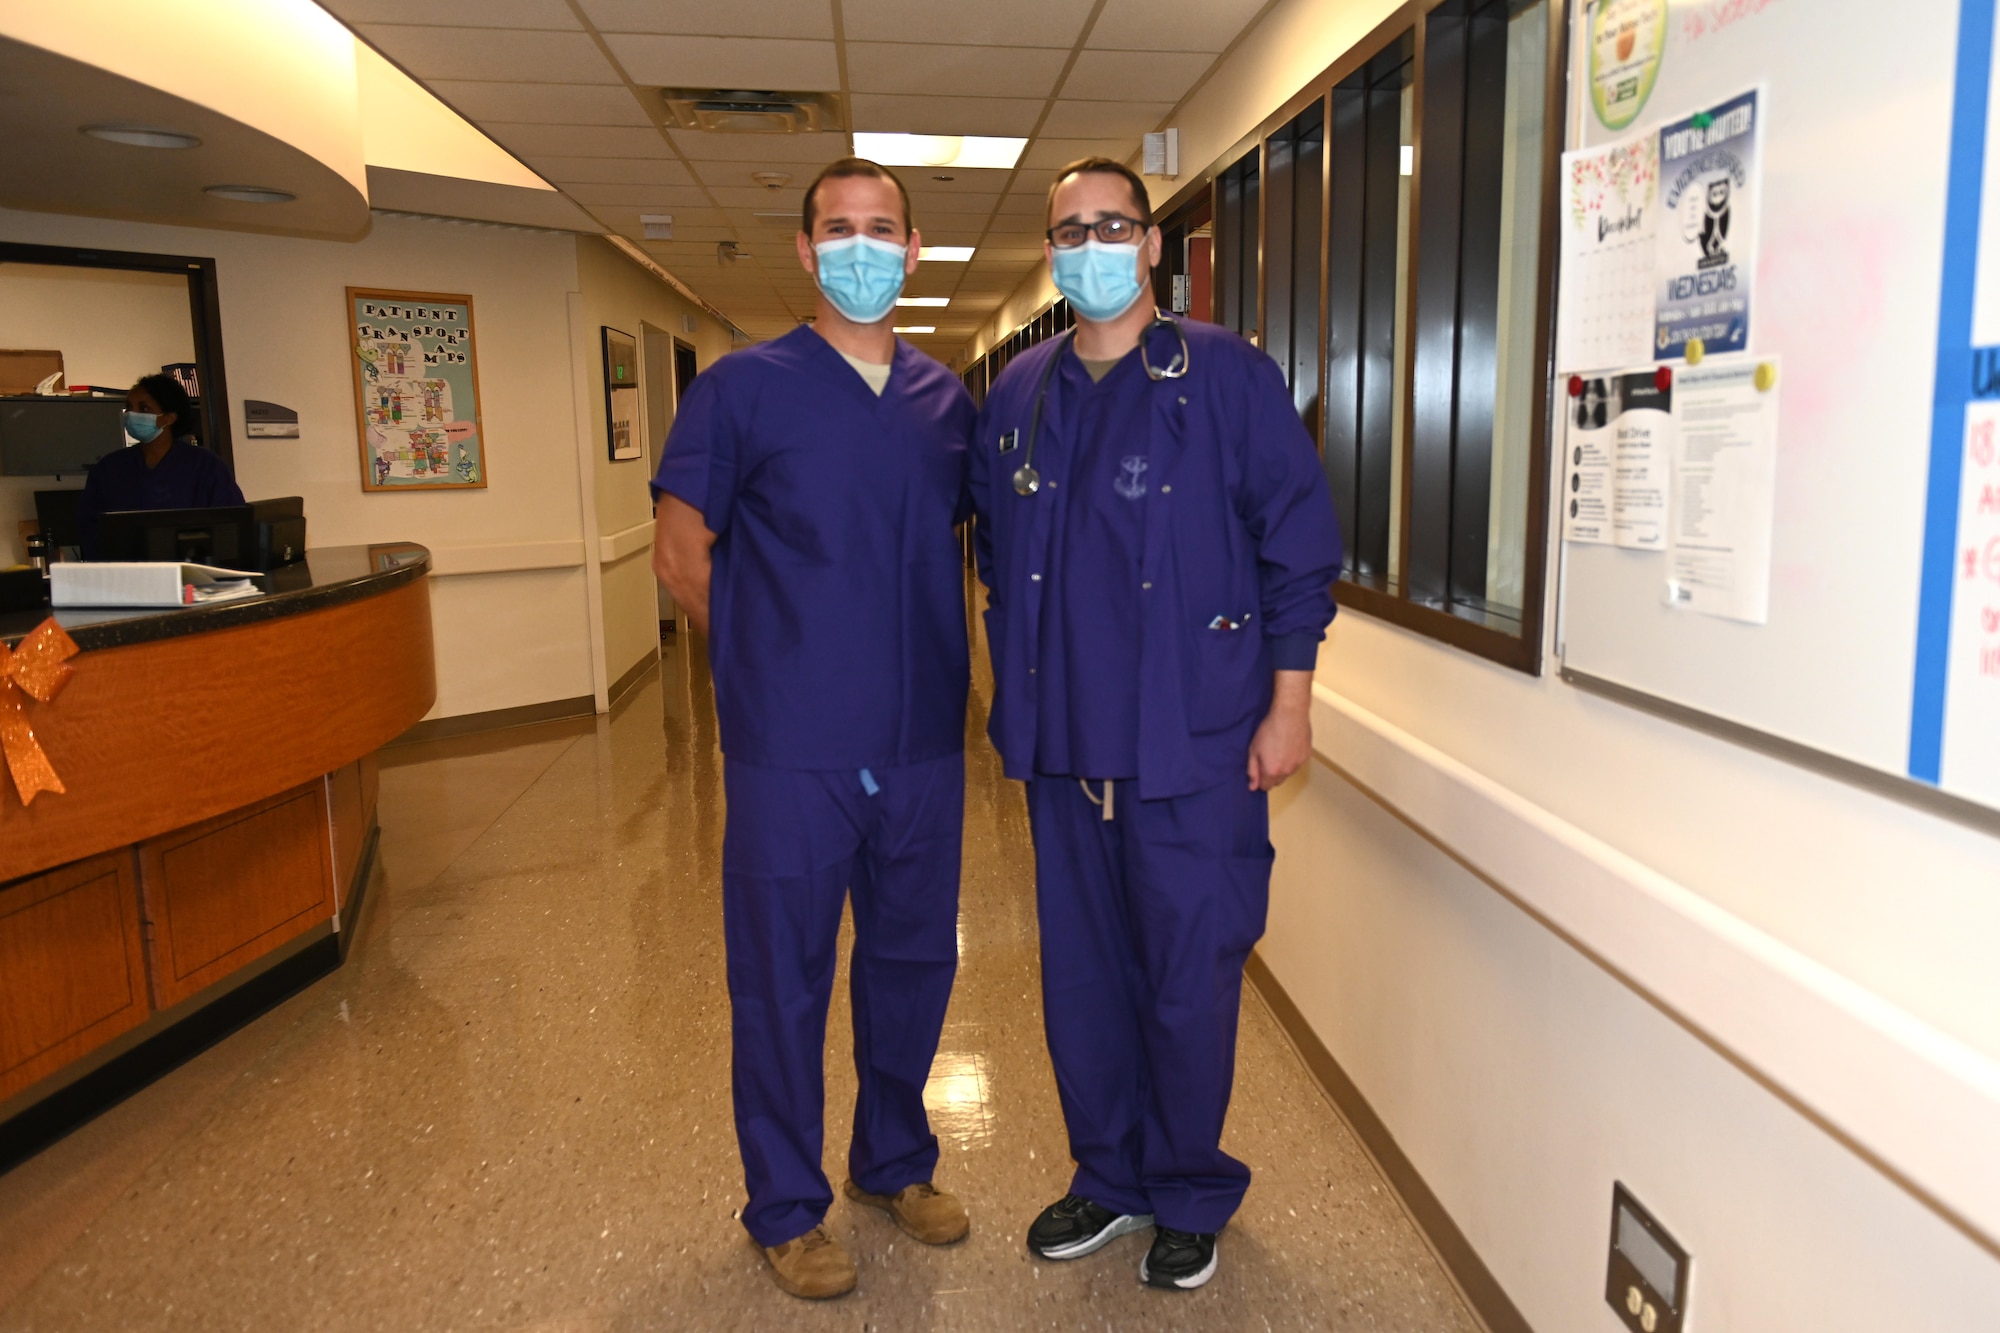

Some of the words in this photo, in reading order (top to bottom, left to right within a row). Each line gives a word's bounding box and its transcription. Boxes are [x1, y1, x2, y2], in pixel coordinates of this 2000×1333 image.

[365, 304, 457, 320] PATIENT
[358, 325, 468, 345] TRANSPORT
[423, 344, 465, 363] MAPS
